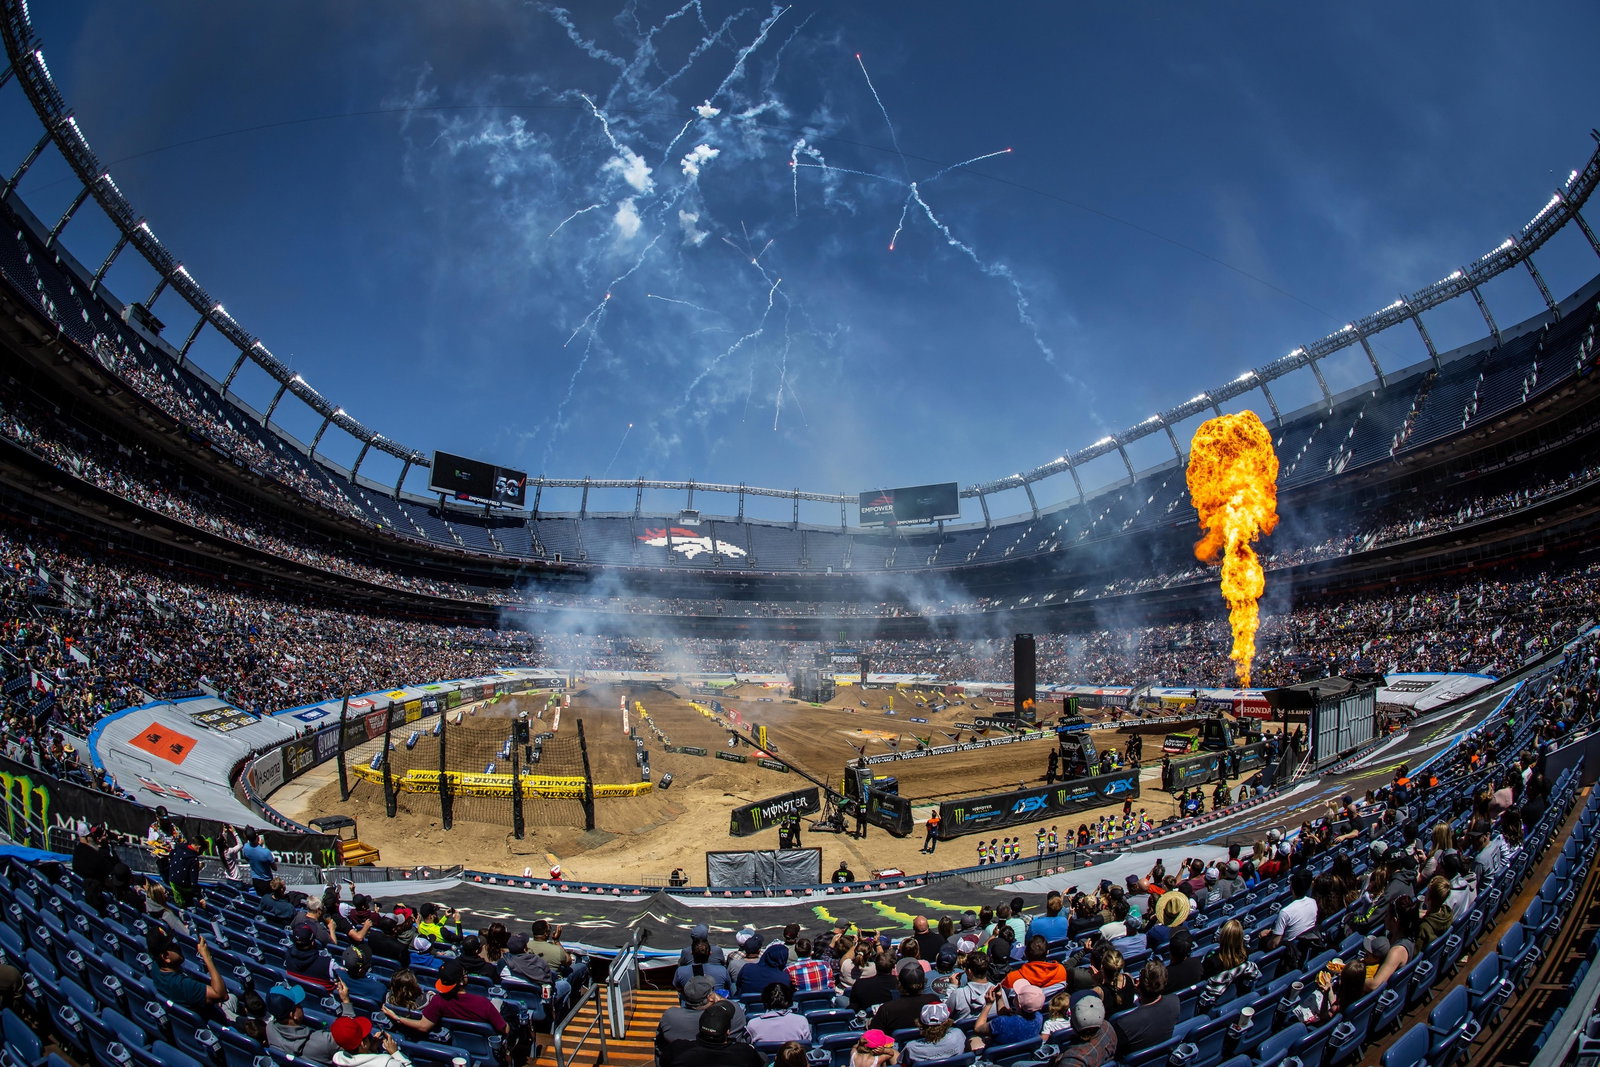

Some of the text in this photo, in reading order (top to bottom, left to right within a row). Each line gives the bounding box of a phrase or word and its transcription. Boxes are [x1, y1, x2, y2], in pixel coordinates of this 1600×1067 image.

[468, 496, 488, 504] EMPOWER
[861, 505, 893, 513] EMPOWER
[1107, 696, 1128, 705] YAMAHA
[1243, 706, 1272, 714] HONDA
[762, 797, 808, 819] MONSTER
[972, 804, 992, 812] MONSTER
